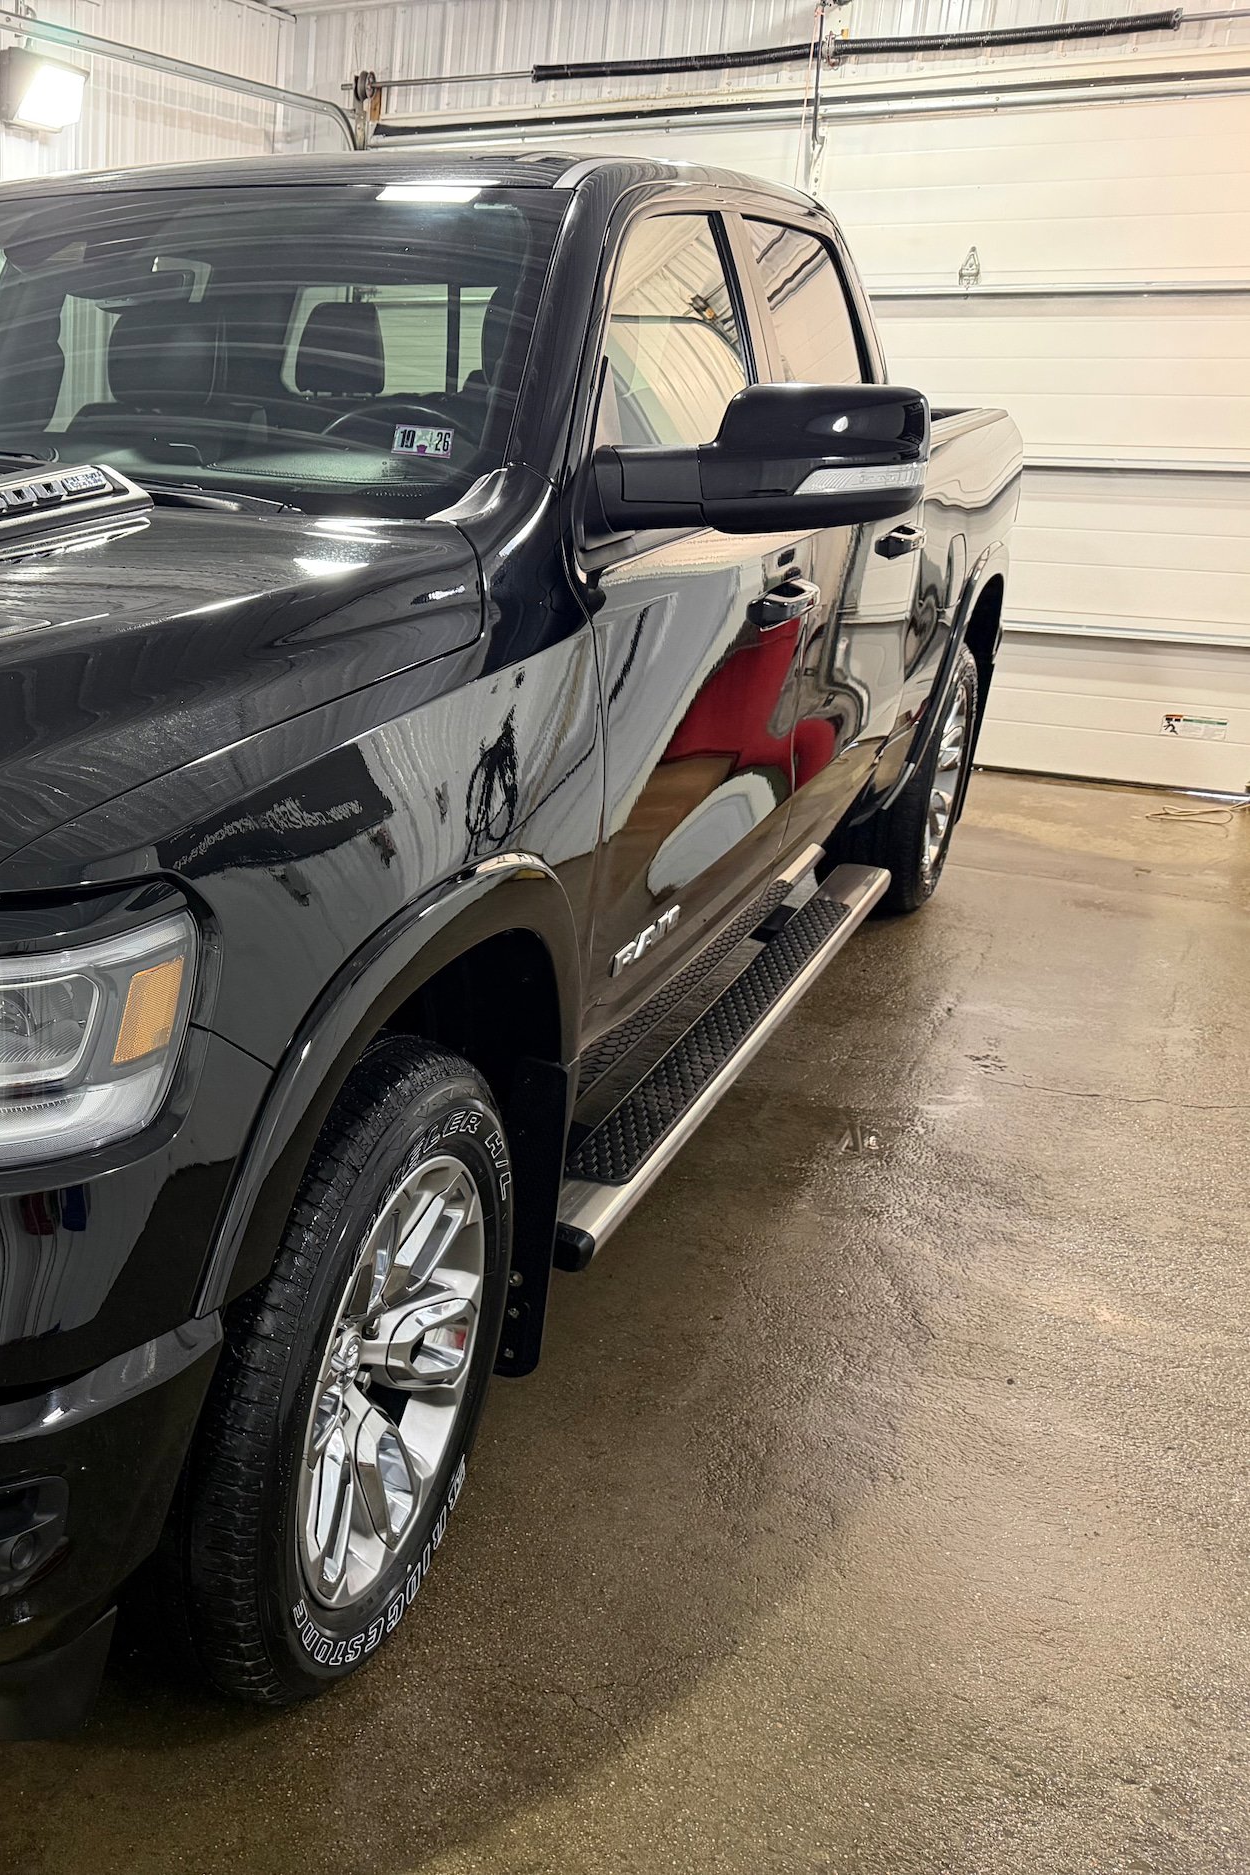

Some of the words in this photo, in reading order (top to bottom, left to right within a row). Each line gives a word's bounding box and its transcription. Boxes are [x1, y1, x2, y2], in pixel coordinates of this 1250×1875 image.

[435, 431, 451, 452] 26
[609, 904, 681, 978] RAM
[485, 1130, 512, 1201] H/L
[292, 1453, 466, 1666] BRIDGESTONE
